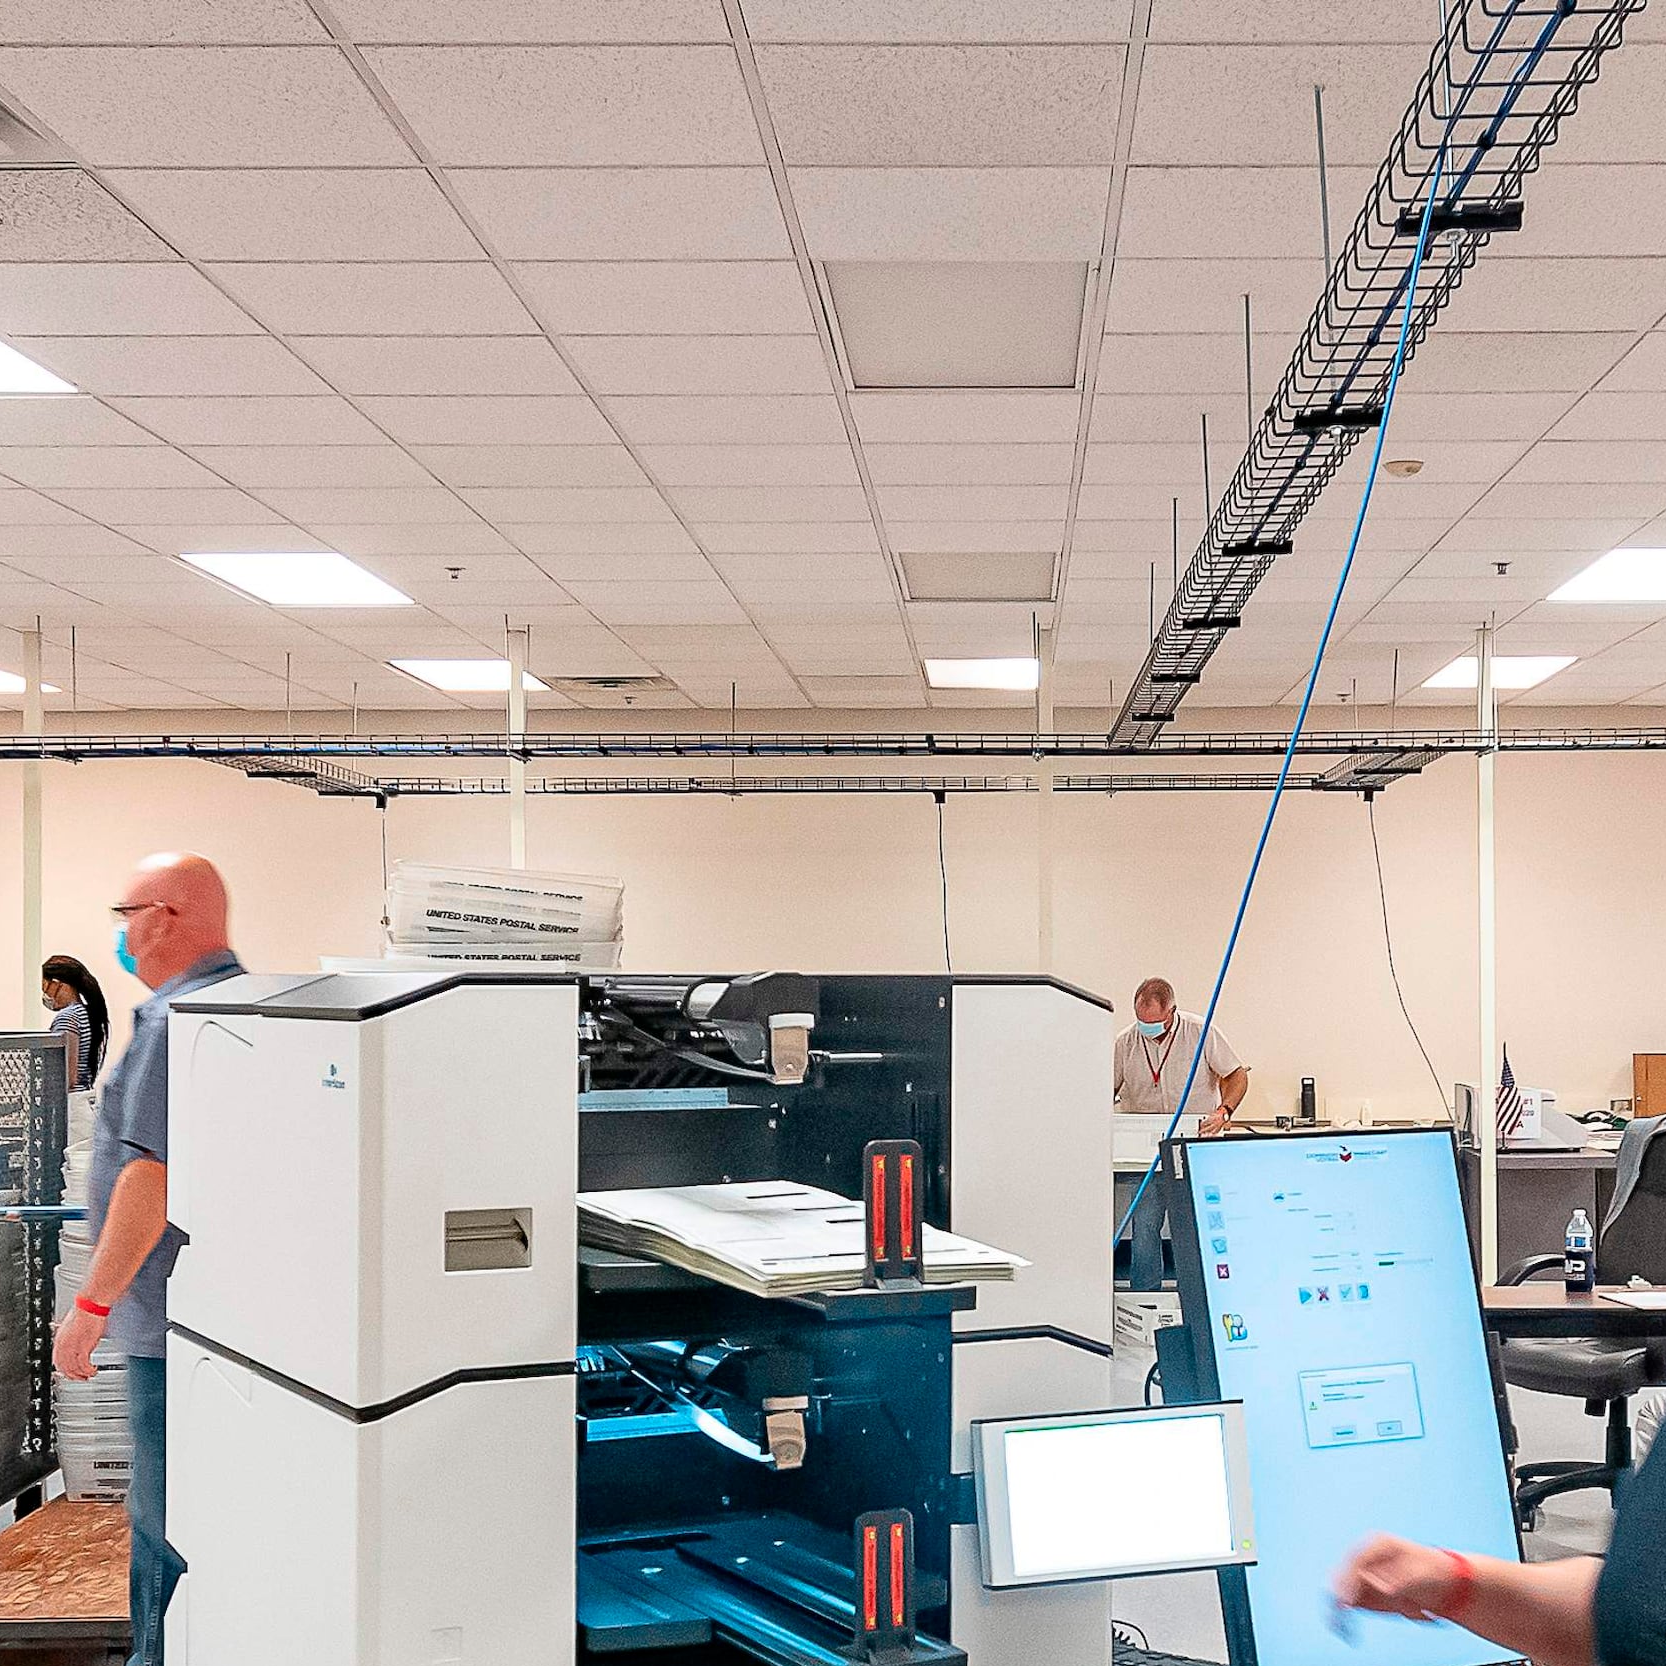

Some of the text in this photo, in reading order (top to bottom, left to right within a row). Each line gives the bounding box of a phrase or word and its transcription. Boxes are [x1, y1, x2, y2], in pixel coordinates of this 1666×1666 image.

[426, 909, 462, 920] UNITED
[463, 914, 499, 925] STATES
[499, 918, 536, 931] POSTAL
